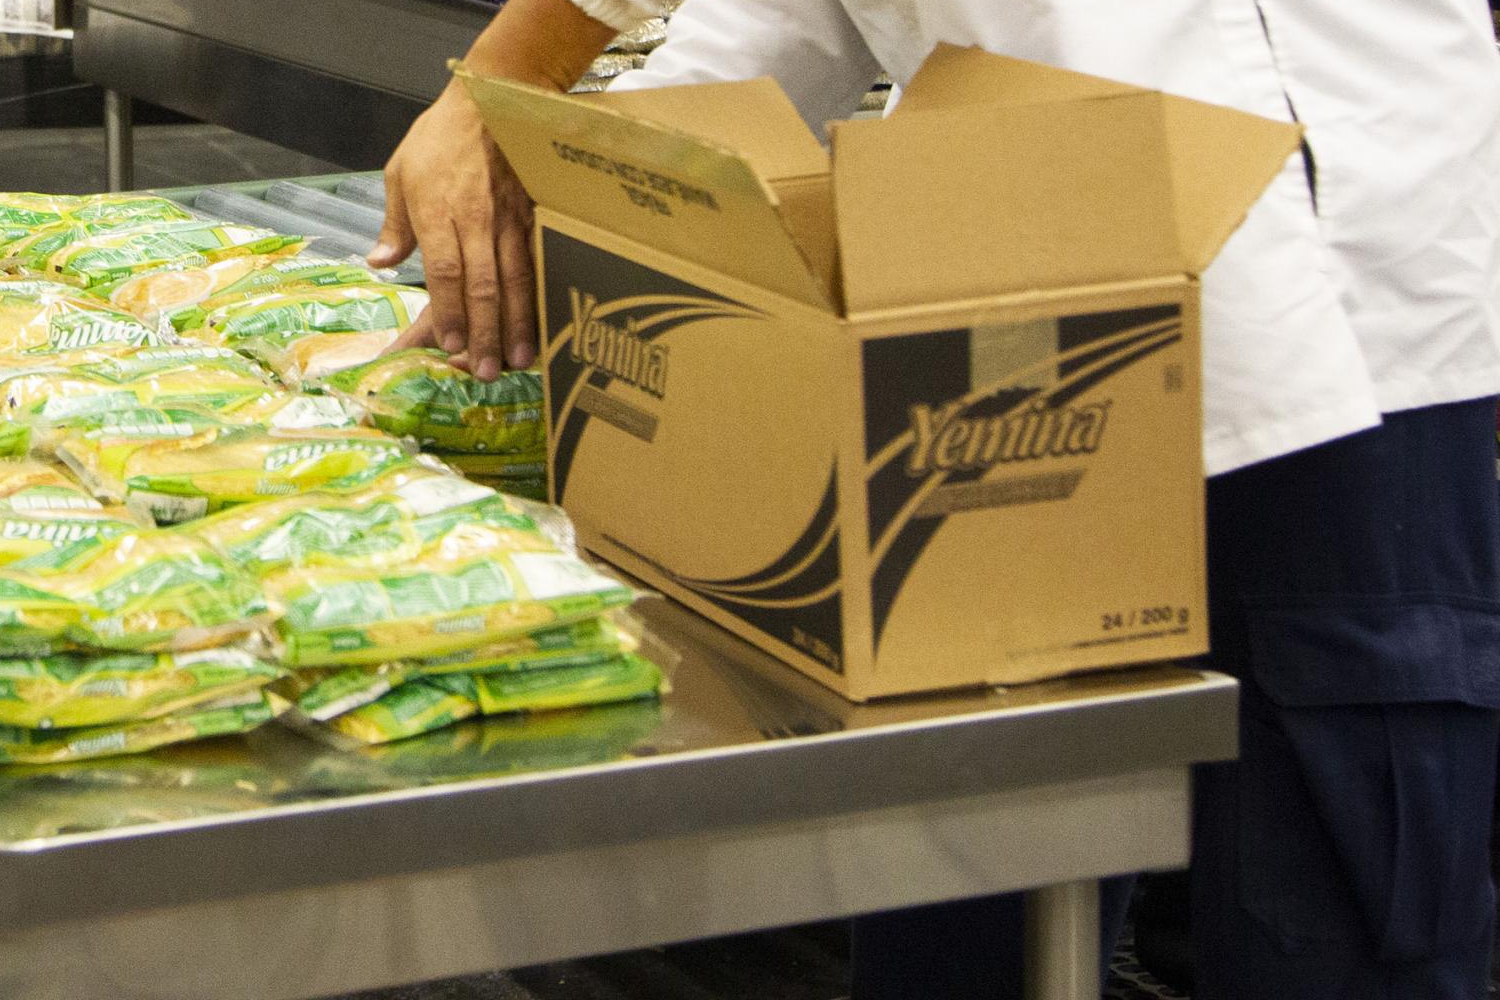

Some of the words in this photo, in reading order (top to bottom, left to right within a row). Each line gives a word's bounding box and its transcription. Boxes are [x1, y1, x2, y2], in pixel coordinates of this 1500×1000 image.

[568, 286, 670, 400] Yemina
[907, 399, 1112, 477] Yemina
[1102, 613, 1124, 630] 24
[1140, 606, 1172, 625] 200
